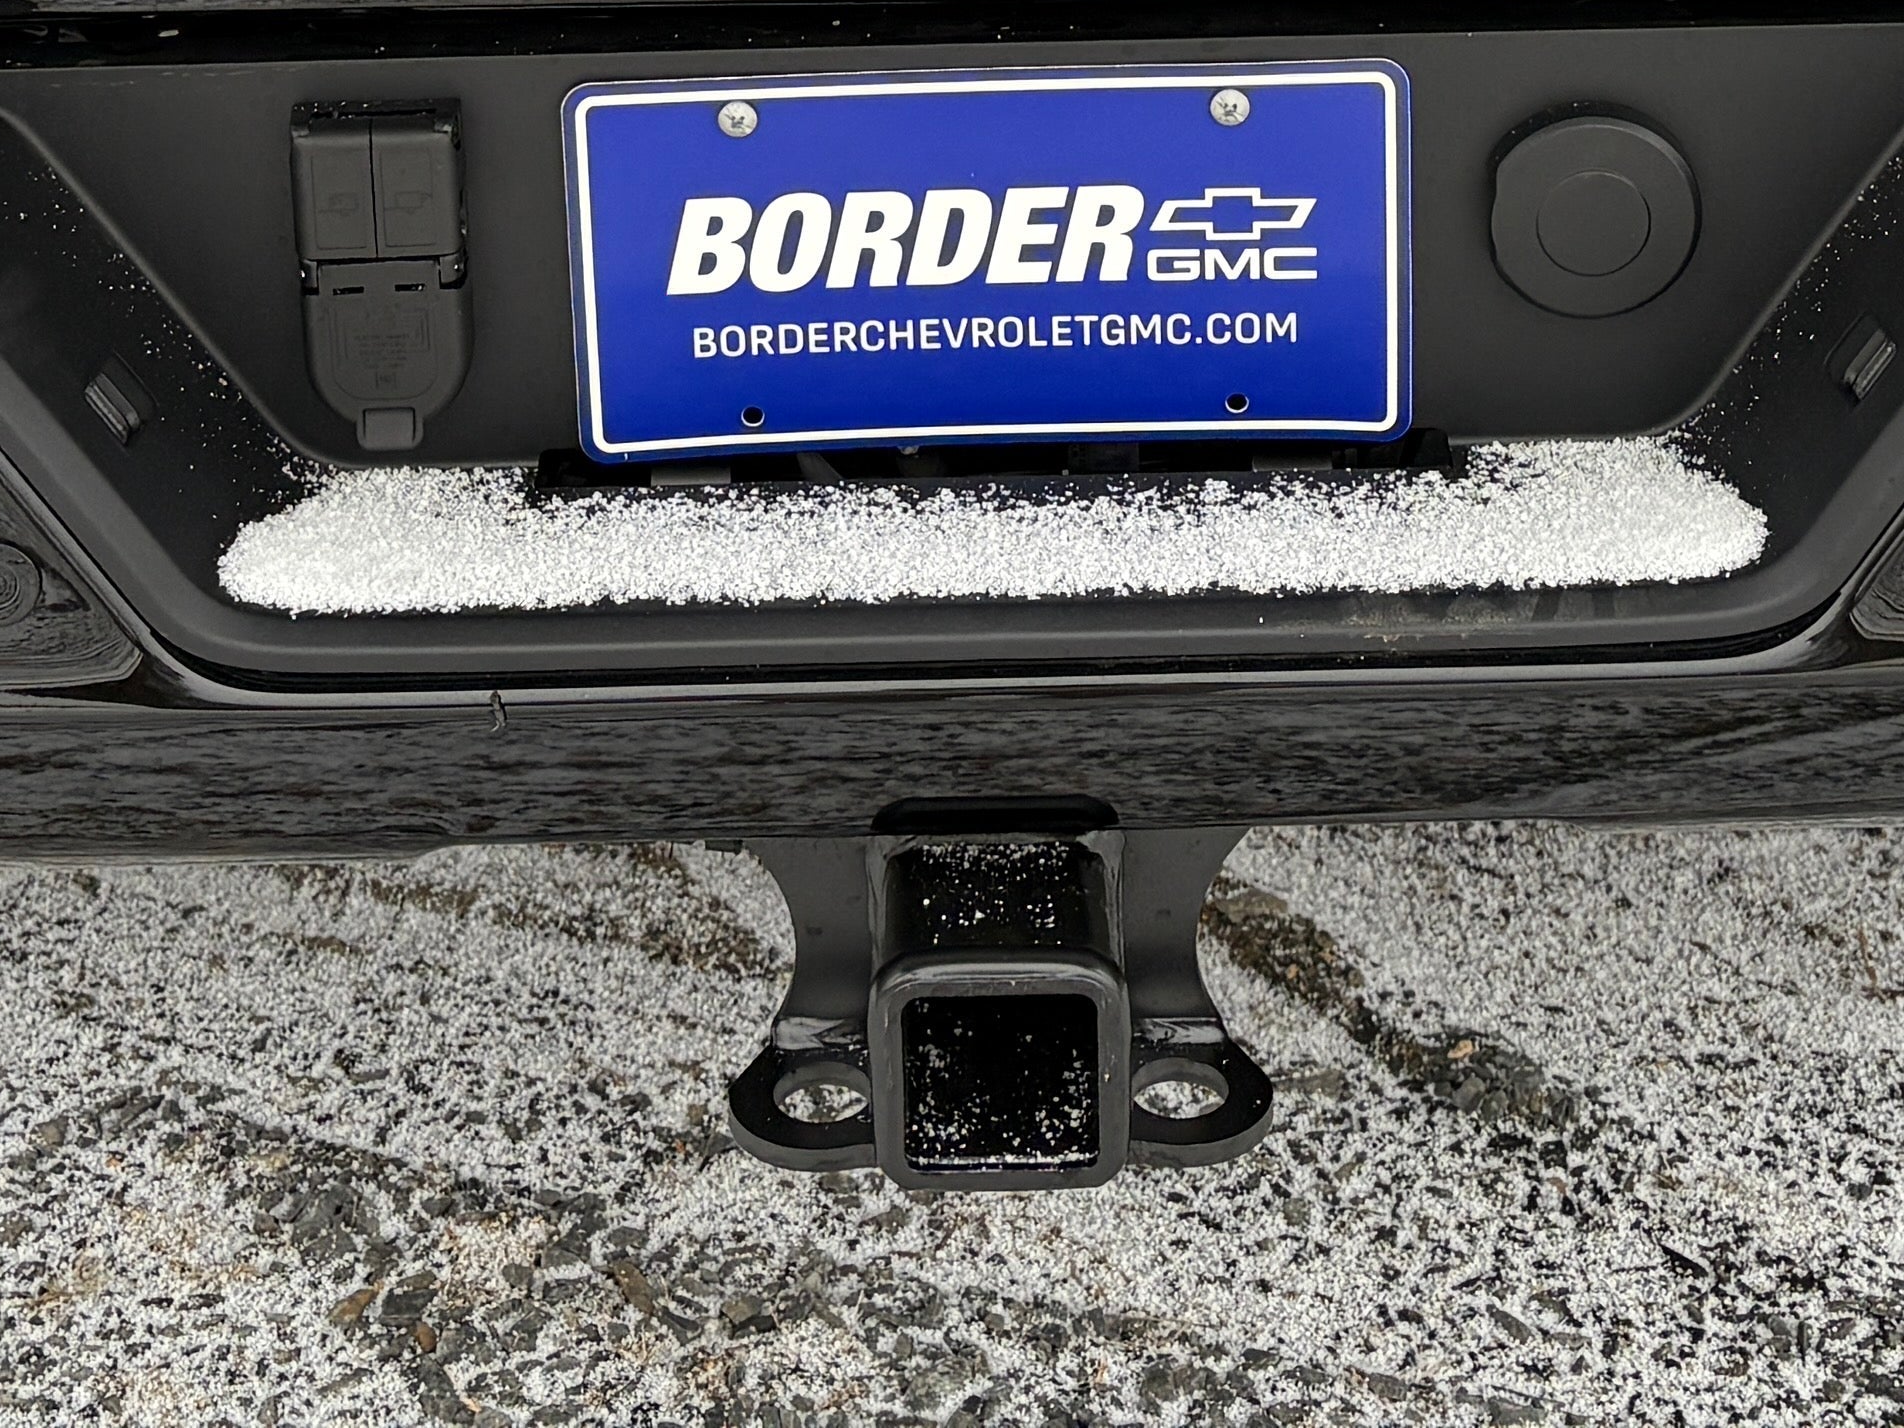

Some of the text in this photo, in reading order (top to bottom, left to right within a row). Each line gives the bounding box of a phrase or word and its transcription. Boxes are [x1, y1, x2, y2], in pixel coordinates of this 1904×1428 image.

[666, 184, 1318, 296] BORDER GMC
[692, 312, 1298, 359] BORDERCHEVROLETGMC.COM
